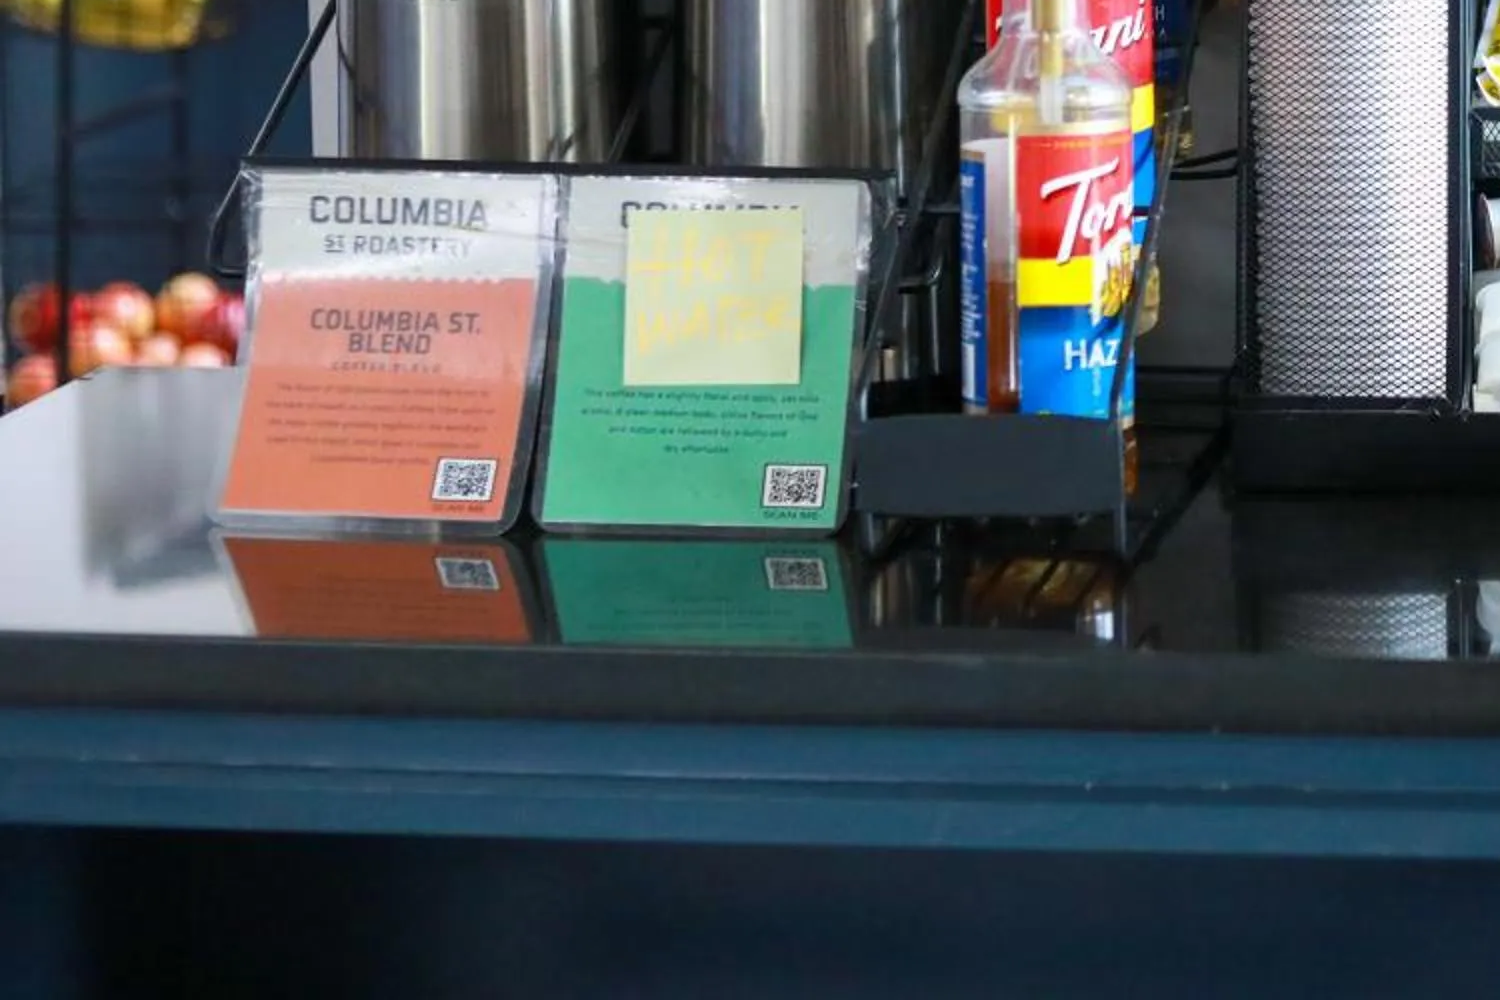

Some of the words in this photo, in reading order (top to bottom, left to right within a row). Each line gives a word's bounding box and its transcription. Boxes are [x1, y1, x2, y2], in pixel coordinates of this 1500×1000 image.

[310, 195, 488, 227] COLUMBIA
[311, 309, 440, 333] COLUMBIA
[448, 312, 481, 335] ST.
[348, 333, 432, 355] BLEND
[1063, 337, 1119, 371] HAZ
